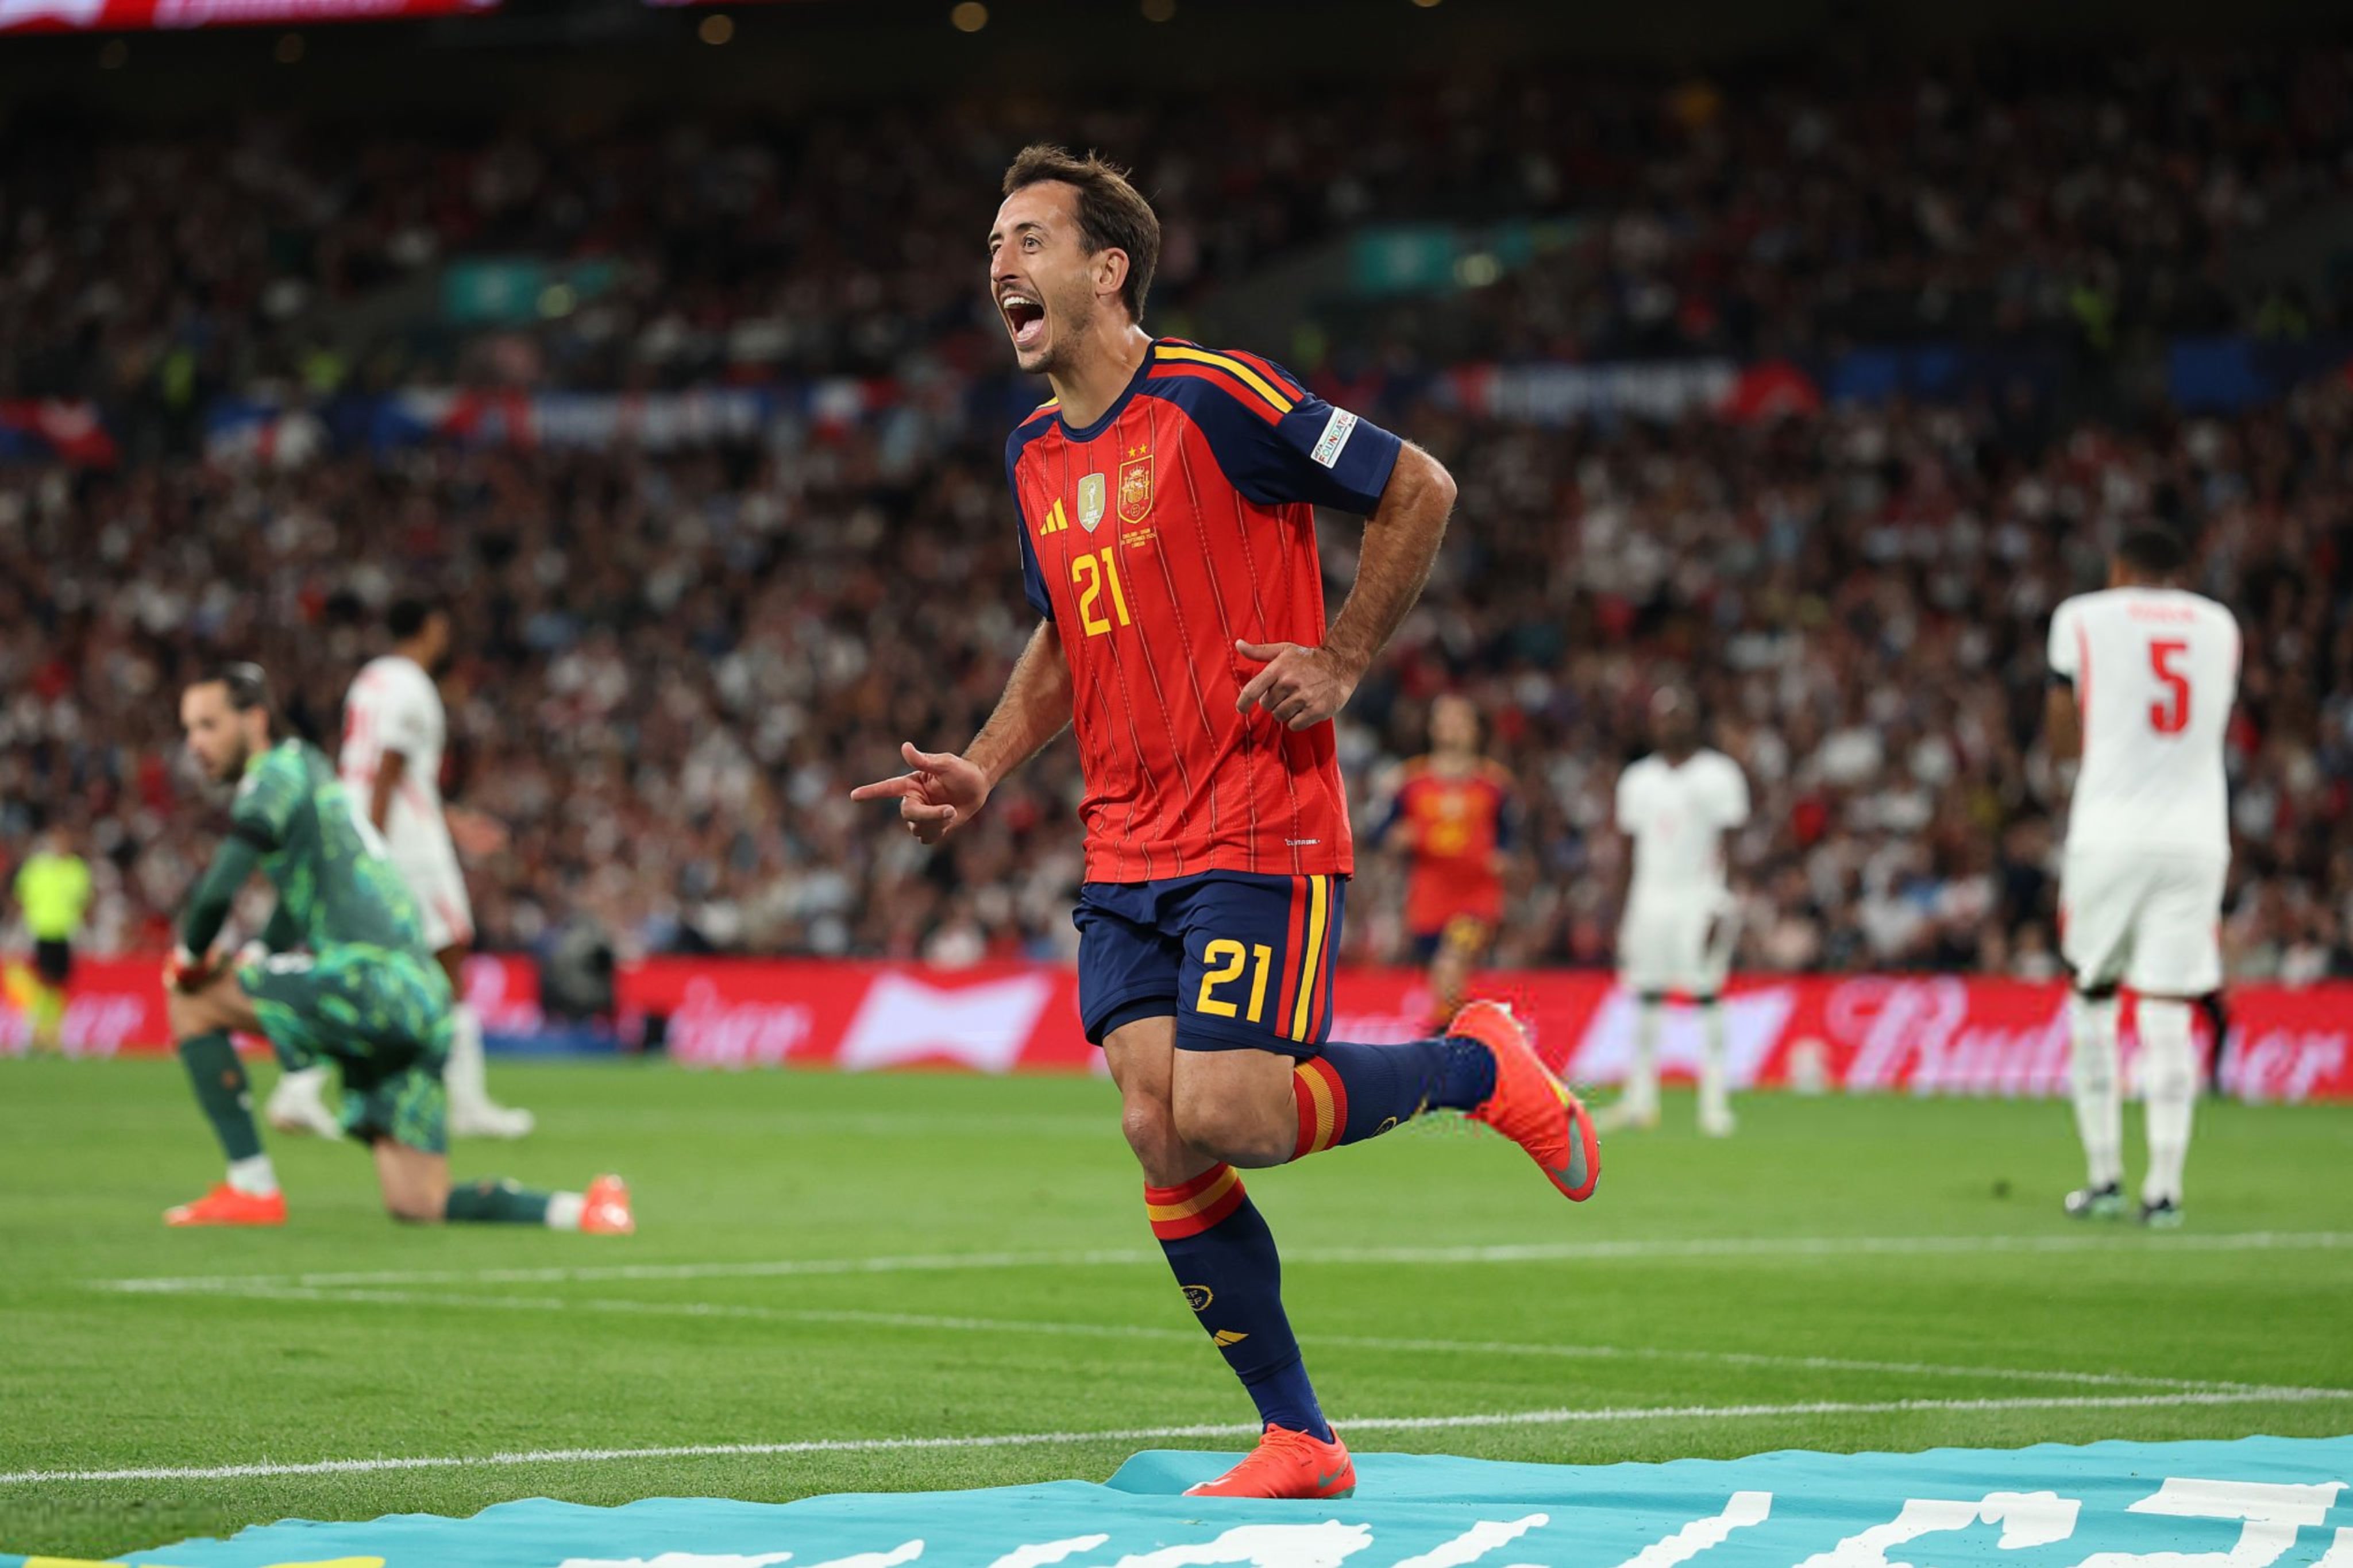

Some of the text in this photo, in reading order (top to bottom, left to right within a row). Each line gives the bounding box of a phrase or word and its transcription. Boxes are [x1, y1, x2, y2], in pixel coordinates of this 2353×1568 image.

[1072, 546, 1131, 637] 21
[2148, 639, 2190, 735] 5
[1196, 939, 1272, 1023] 21
